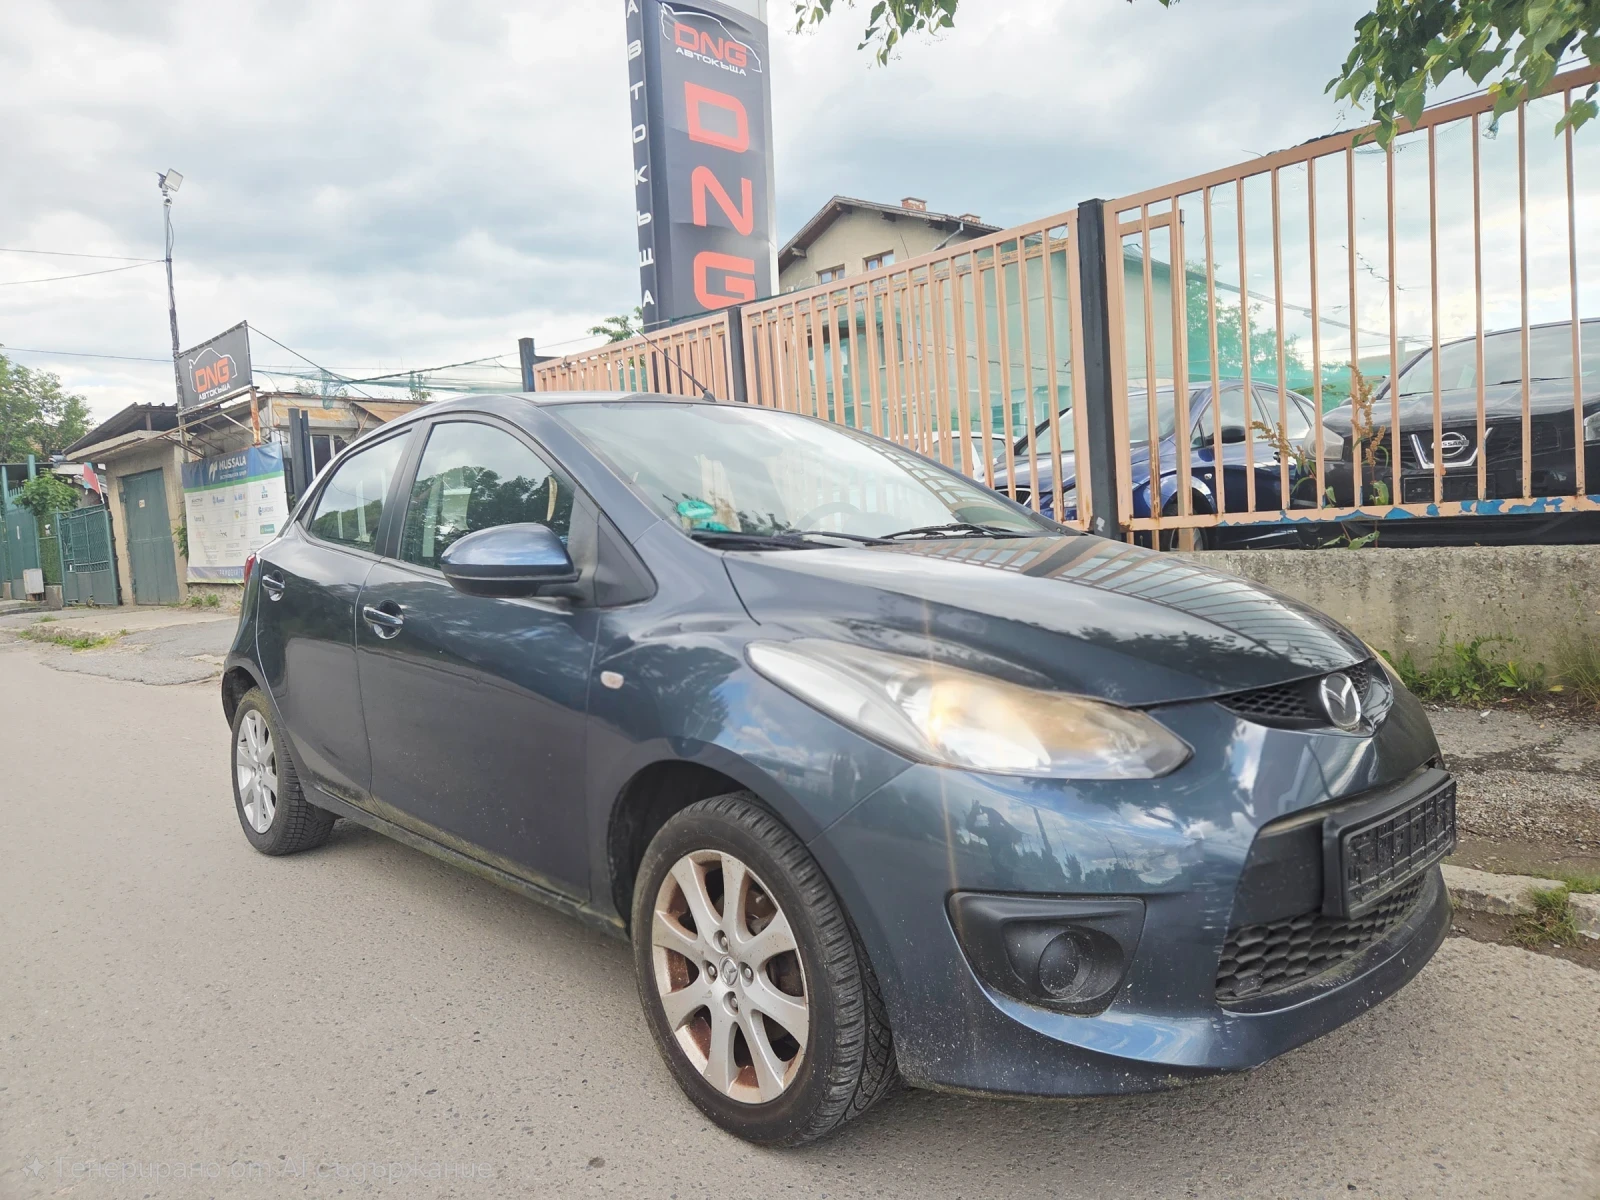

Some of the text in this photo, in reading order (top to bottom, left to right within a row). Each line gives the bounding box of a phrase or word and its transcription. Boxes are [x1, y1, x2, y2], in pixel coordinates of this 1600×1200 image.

[674, 22, 746, 67] DNG
[684, 81, 755, 310] DNG
[195, 357, 229, 393] DNG
[219, 455, 247, 470] MUSSALA
